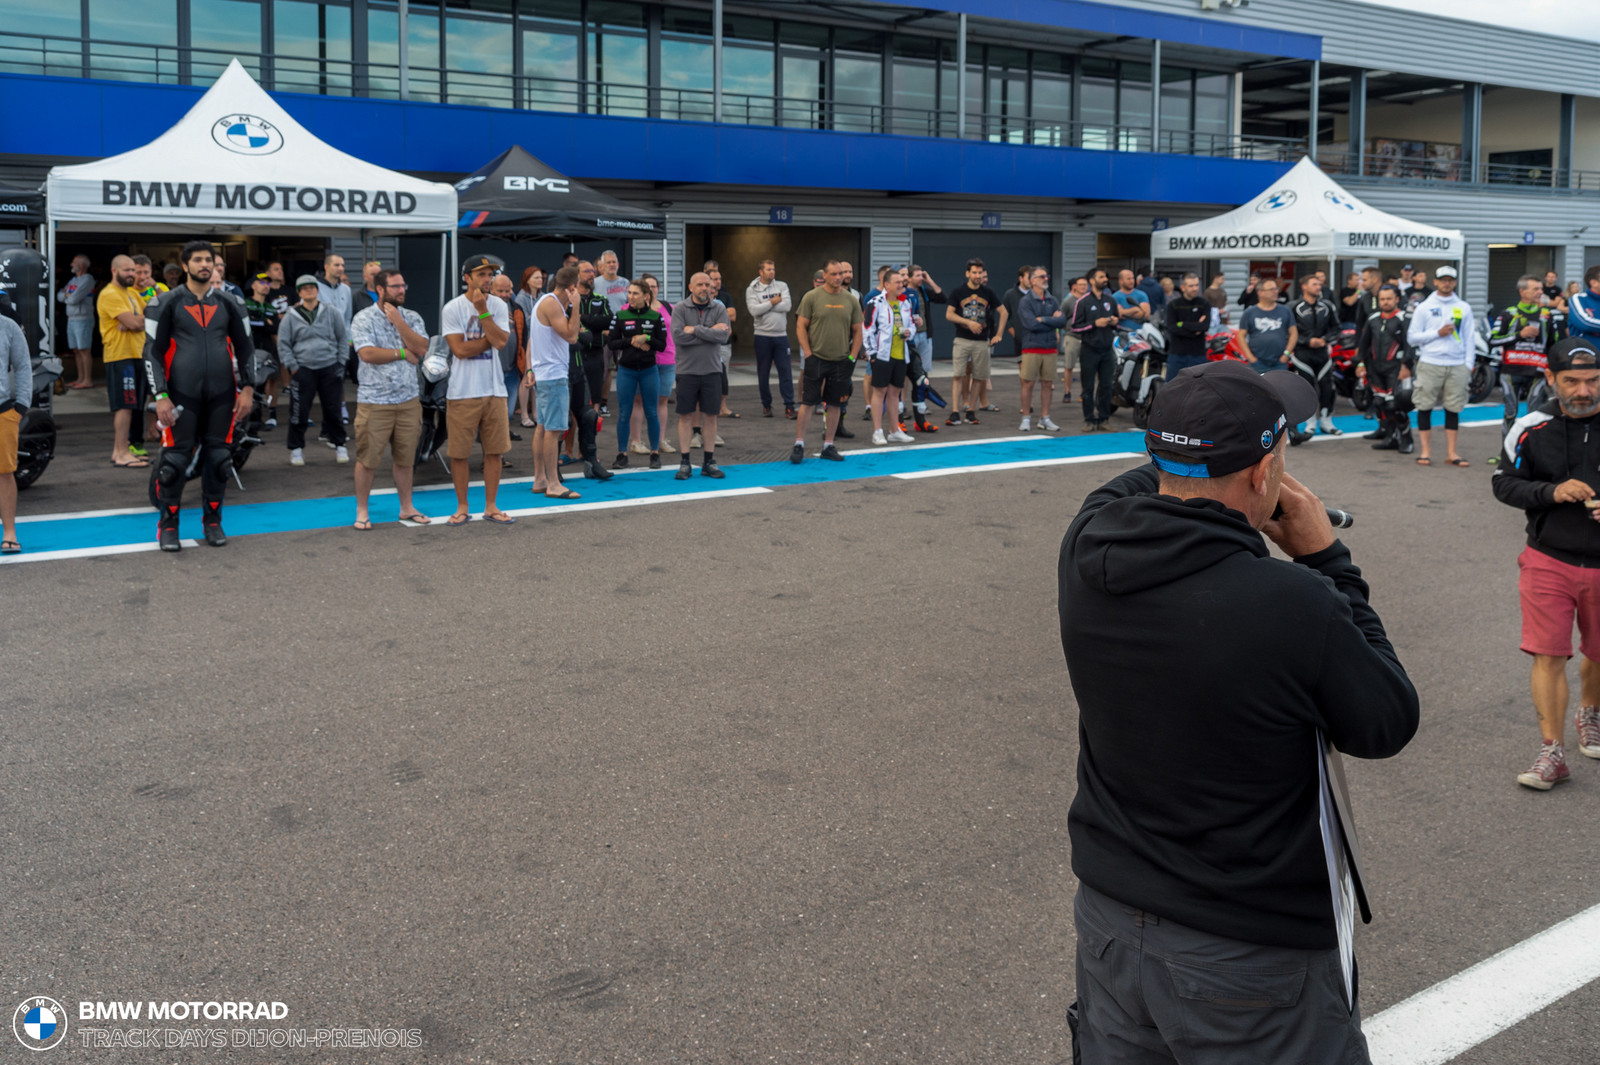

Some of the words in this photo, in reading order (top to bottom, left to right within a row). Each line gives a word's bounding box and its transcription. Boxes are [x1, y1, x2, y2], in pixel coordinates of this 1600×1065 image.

[220, 116, 271, 130] BMW
[503, 176, 570, 193] BMC
[102, 180, 201, 208] BMW
[215, 184, 417, 215] MOTORRAD
[776, 210, 787, 220] 18
[597, 218, 654, 231] bmc-moto.com
[1169, 236, 1207, 250] BMW
[1212, 233, 1310, 249] MOTORRAD
[1348, 232, 1379, 248] BMW
[1384, 233, 1450, 250] MOTORRAD
[1161, 431, 1188, 445] 50
